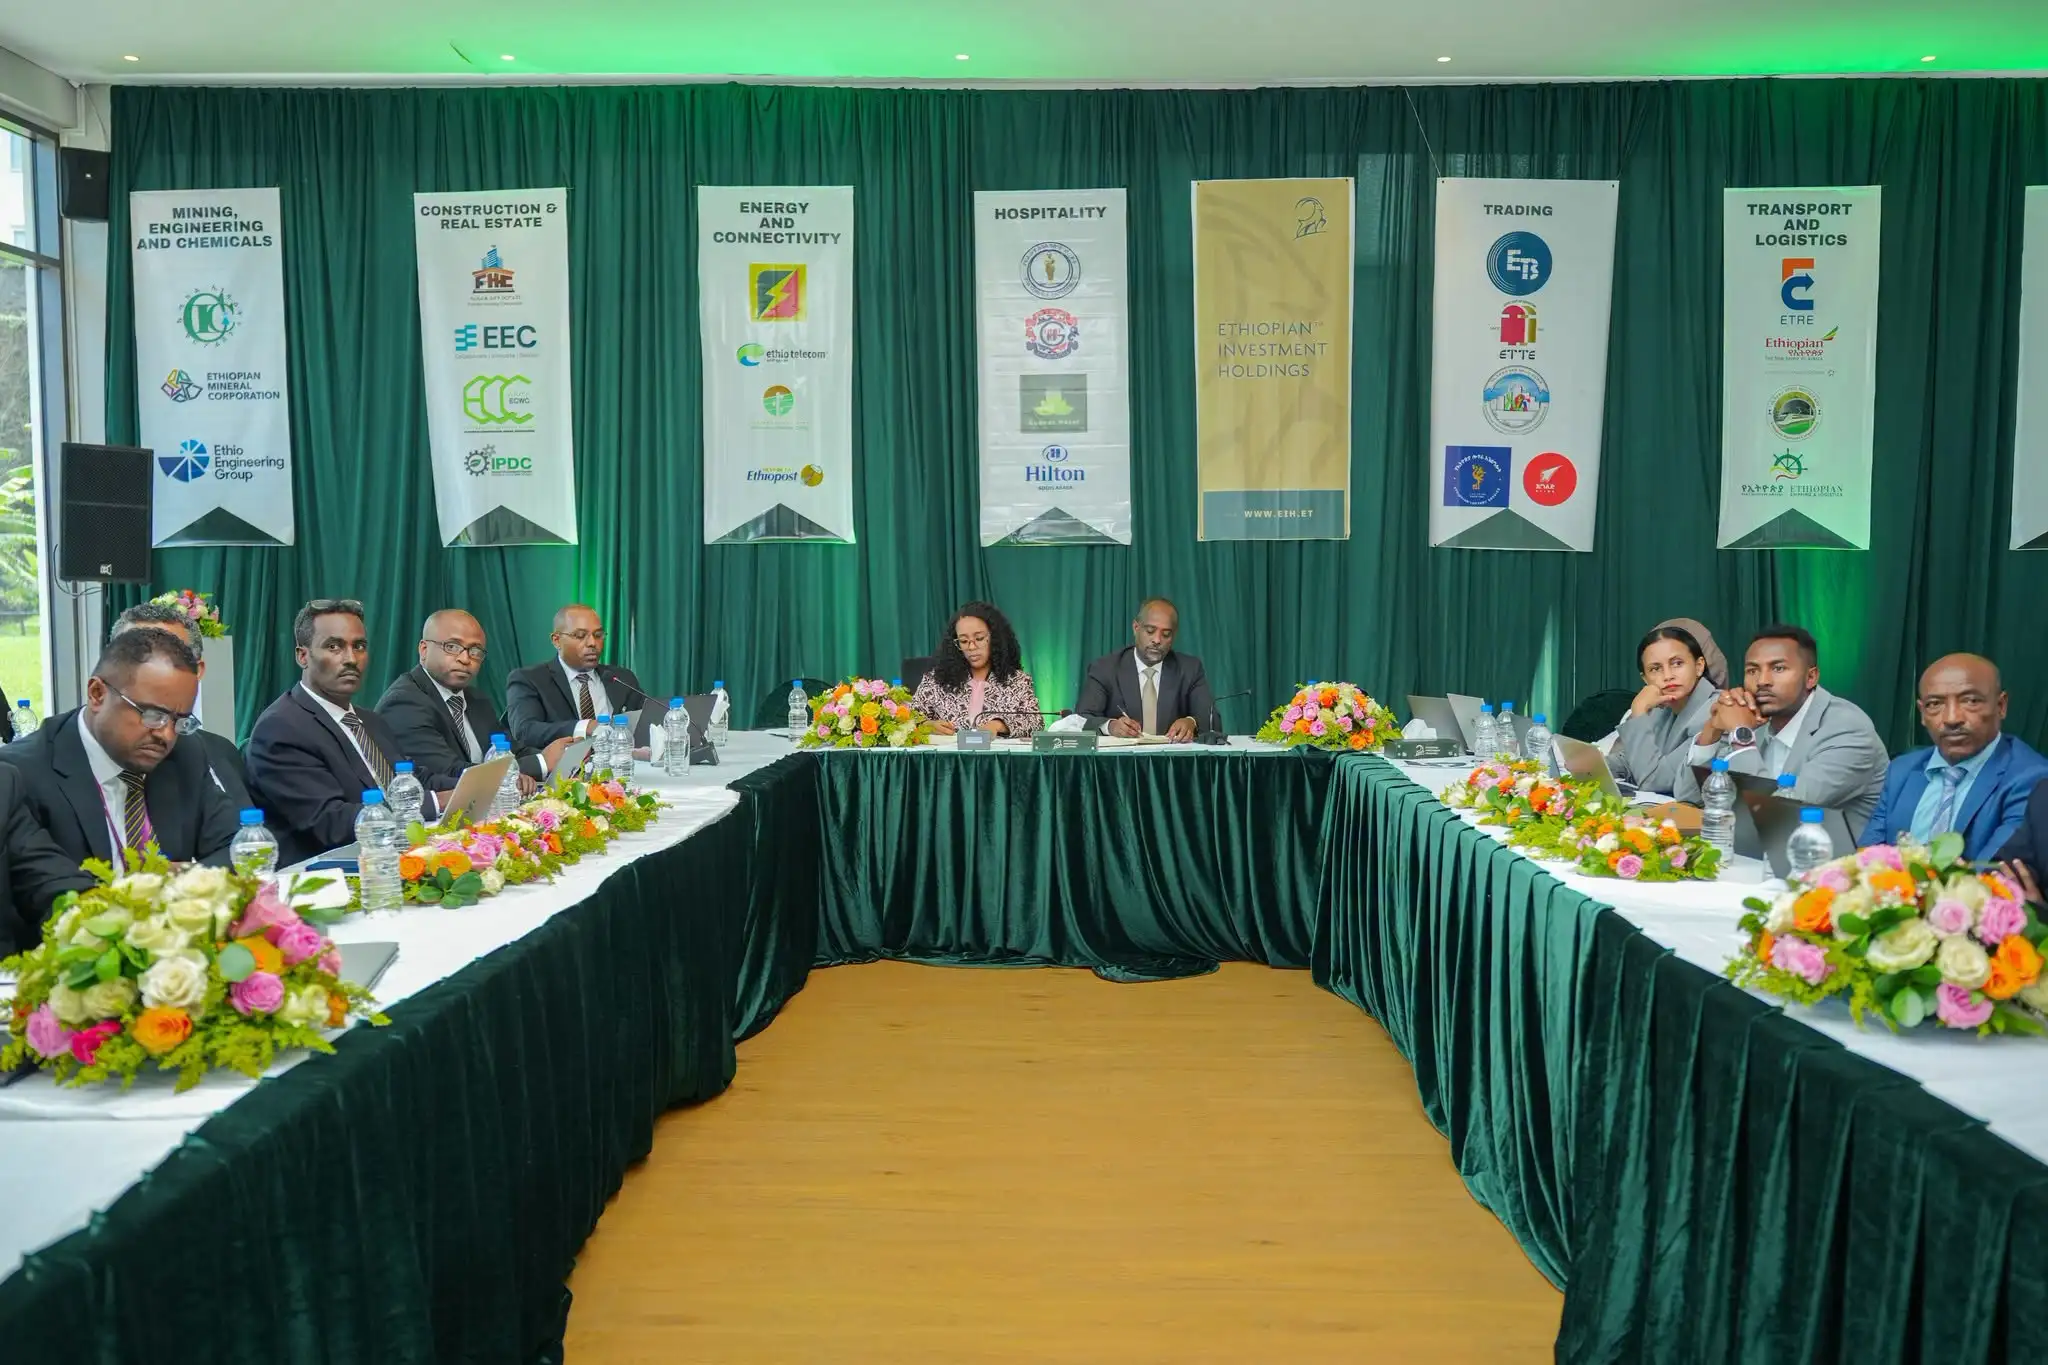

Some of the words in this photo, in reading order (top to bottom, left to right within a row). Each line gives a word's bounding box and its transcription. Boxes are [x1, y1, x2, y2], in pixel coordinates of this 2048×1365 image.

[172, 206, 238, 219] MINING,
[421, 203, 540, 216] CONSTRUCTION
[546, 203, 558, 214] &
[740, 202, 809, 214] ENERGY
[995, 206, 1107, 220] HOSPITALITY
[1484, 204, 1553, 216] TRADING
[1747, 203, 1852, 216] TRANSPORT
[149, 220, 264, 234] ENGINEERING
[441, 218, 480, 229] REAL
[485, 217, 542, 229] ESTATE
[759, 217, 795, 229] AND
[1783, 219, 1820, 231] AND
[136, 238, 171, 250] AND
[176, 235, 273, 249] CHEMICALS
[713, 231, 841, 245] CONNECTIVITY
[1755, 234, 1848, 246] LOGISTICS
[1780, 315, 1814, 325] ETRE
[1218, 322, 1312, 336] ETHIOPIAN
[483, 325, 537, 349] EEC
[1765, 337, 1824, 350] Ethiopian
[766, 349, 789, 359] ethio
[790, 349, 826, 359] telecom
[1218, 342, 1328, 358] INVESTMENT
[1499, 350, 1536, 360] ETTE
[207, 372, 261, 381] ETHIOPIAN
[1218, 364, 1310, 378] HOLDINGS
[207, 382, 252, 391] MINERAL
[207, 391, 280, 401] CORPORATION
[214, 444, 244, 456] Ethio
[214, 456, 285, 470] Engineering
[491, 457, 532, 470] IPDC
[214, 469, 253, 482] Group
[746, 469, 798, 484] Ethiopost
[1025, 465, 1085, 482] Hilton
[1790, 484, 1843, 493] ETHIOPIAN
[1244, 509, 1314, 518] WWW.EIH.ET
